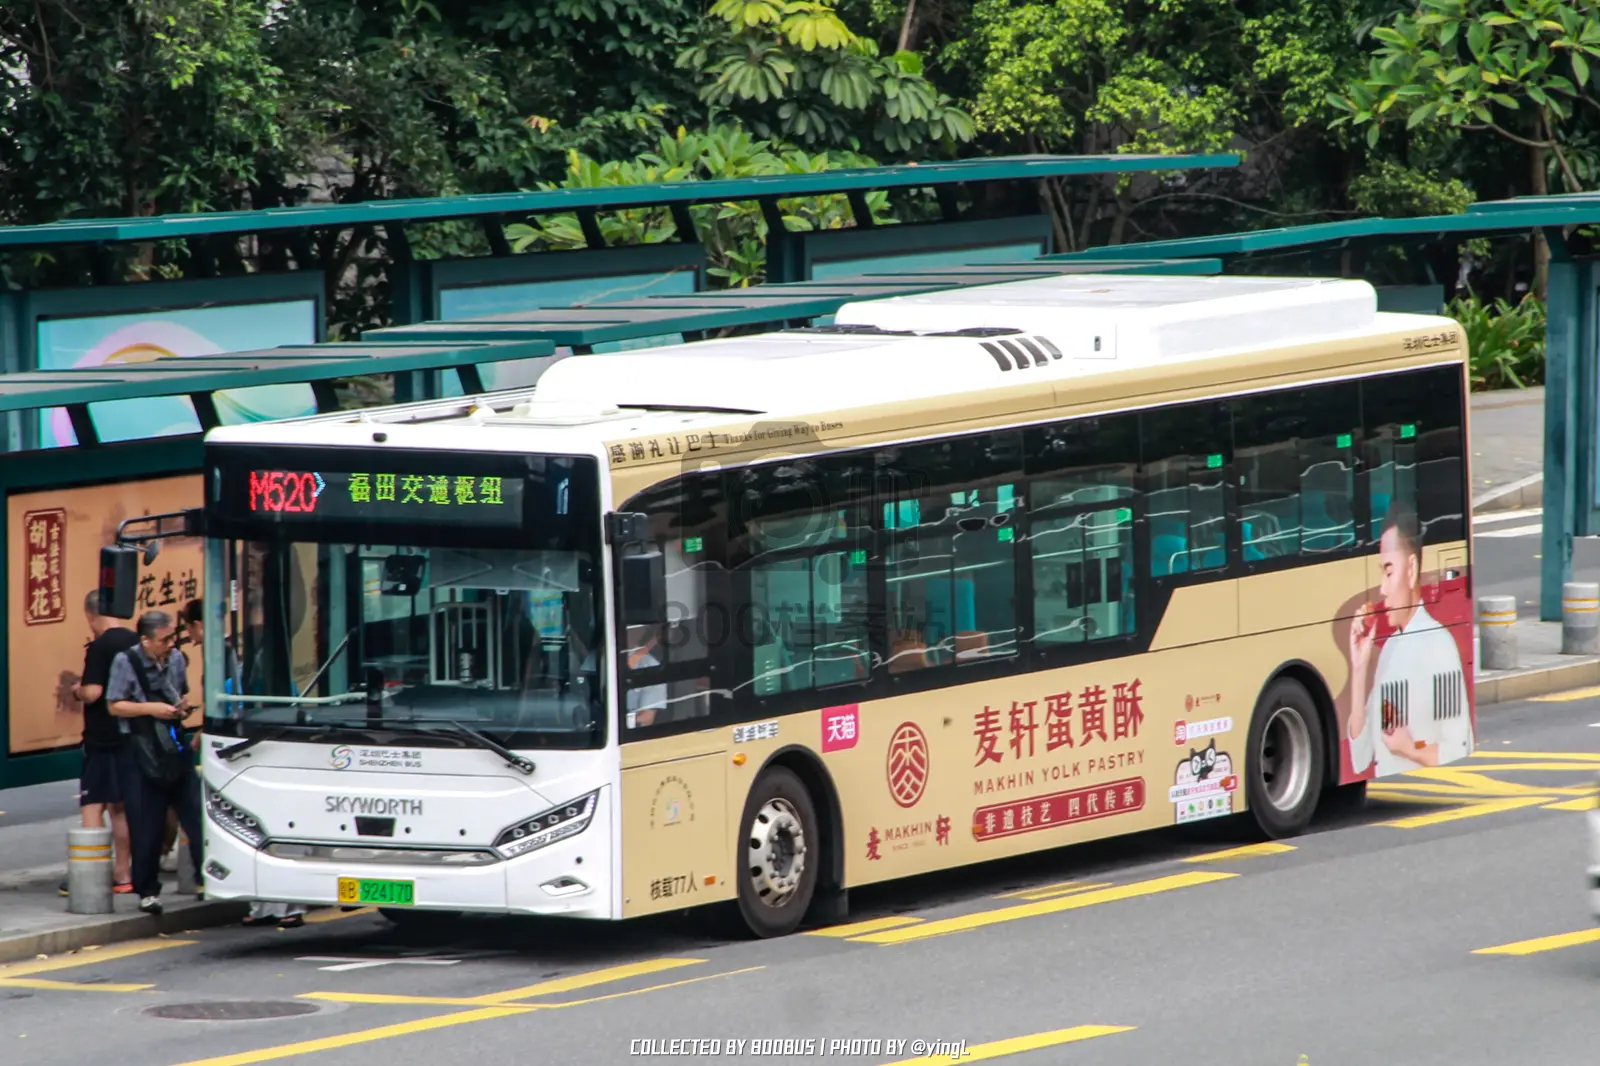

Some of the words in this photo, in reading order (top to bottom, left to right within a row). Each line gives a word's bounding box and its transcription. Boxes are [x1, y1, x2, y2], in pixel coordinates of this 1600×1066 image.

[610, 431, 720, 463] 感谢礼让巴士
[724, 432, 752, 445] Thanks
[754, 429, 766, 441] for
[767, 427, 793, 441] Giving
[794, 424, 810, 438] Way
[821, 421, 844, 433] Buses
[249, 471, 317, 512] M520
[348, 473, 504, 505] 福田交通枢纽
[30, 519, 50, 618] 胡姬花
[828, 714, 856, 742] 天猫
[973, 678, 1145, 768] 麦轩蛋黄酥
[974, 770, 1035, 796] MAKHIN
[1041, 761, 1081, 782] YOLK
[1088, 750, 1146, 774] PASTRY
[325, 795, 424, 815] SKYWORTH
[984, 801, 1052, 834] 非遗技艺
[1067, 785, 1135, 817] 四代传承
[866, 827, 882, 861] 麦
[884, 821, 932, 842] MAKHIN
[935, 814, 952, 846] 轩
[650, 871, 698, 900] 核载77人
